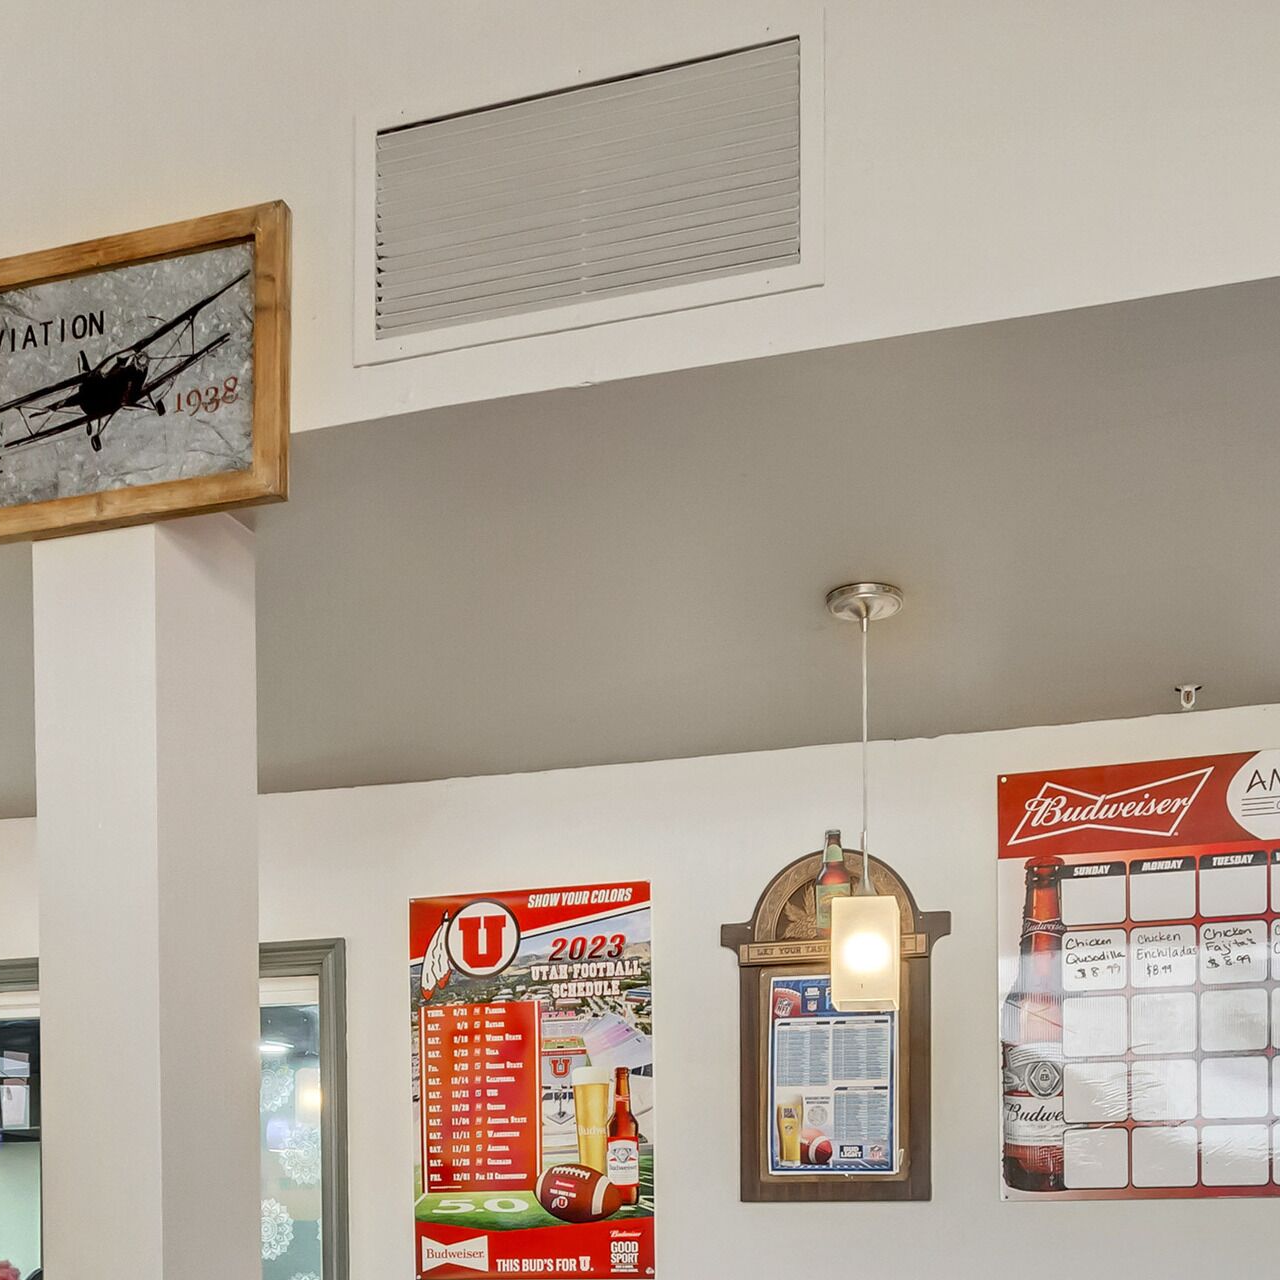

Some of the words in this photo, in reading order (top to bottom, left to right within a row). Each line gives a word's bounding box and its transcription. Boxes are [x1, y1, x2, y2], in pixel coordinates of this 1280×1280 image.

[174, 376, 241, 417] 1938
[1024, 793, 1192, 827] Budweiser
[1073, 865, 1111, 876] SUNDAY
[1141, 859, 1183, 871] MONDAY
[1212, 854, 1254, 867] TUESDAY
[528, 891, 560, 909] SHOW
[561, 889, 589, 906] YOUR
[590, 887, 633, 904] COLORS
[458, 914, 507, 969] U
[1137, 931, 1181, 944] Chicken
[1203, 928, 1252, 941] Chicken
[548, 933, 625, 962] 2023
[807, 944, 829, 952] TAST
[1065, 938, 1112, 951] Chicken
[1136, 945, 1197, 961] Enchiladas
[530, 962, 571, 981] UTAH
[572, 960, 641, 980] FOOTBALL
[551, 979, 621, 999] SCHEDULE
[1005, 1102, 1063, 1122] Budwe
[426, 1247, 484, 1260] Budweiser
[610, 1241, 639, 1253] GOOD
[496, 1258, 520, 1273] THIS
[522, 1258, 553, 1272] BUD'S
[555, 1258, 577, 1272] FOR
[610, 1252, 639, 1264] SPORT
